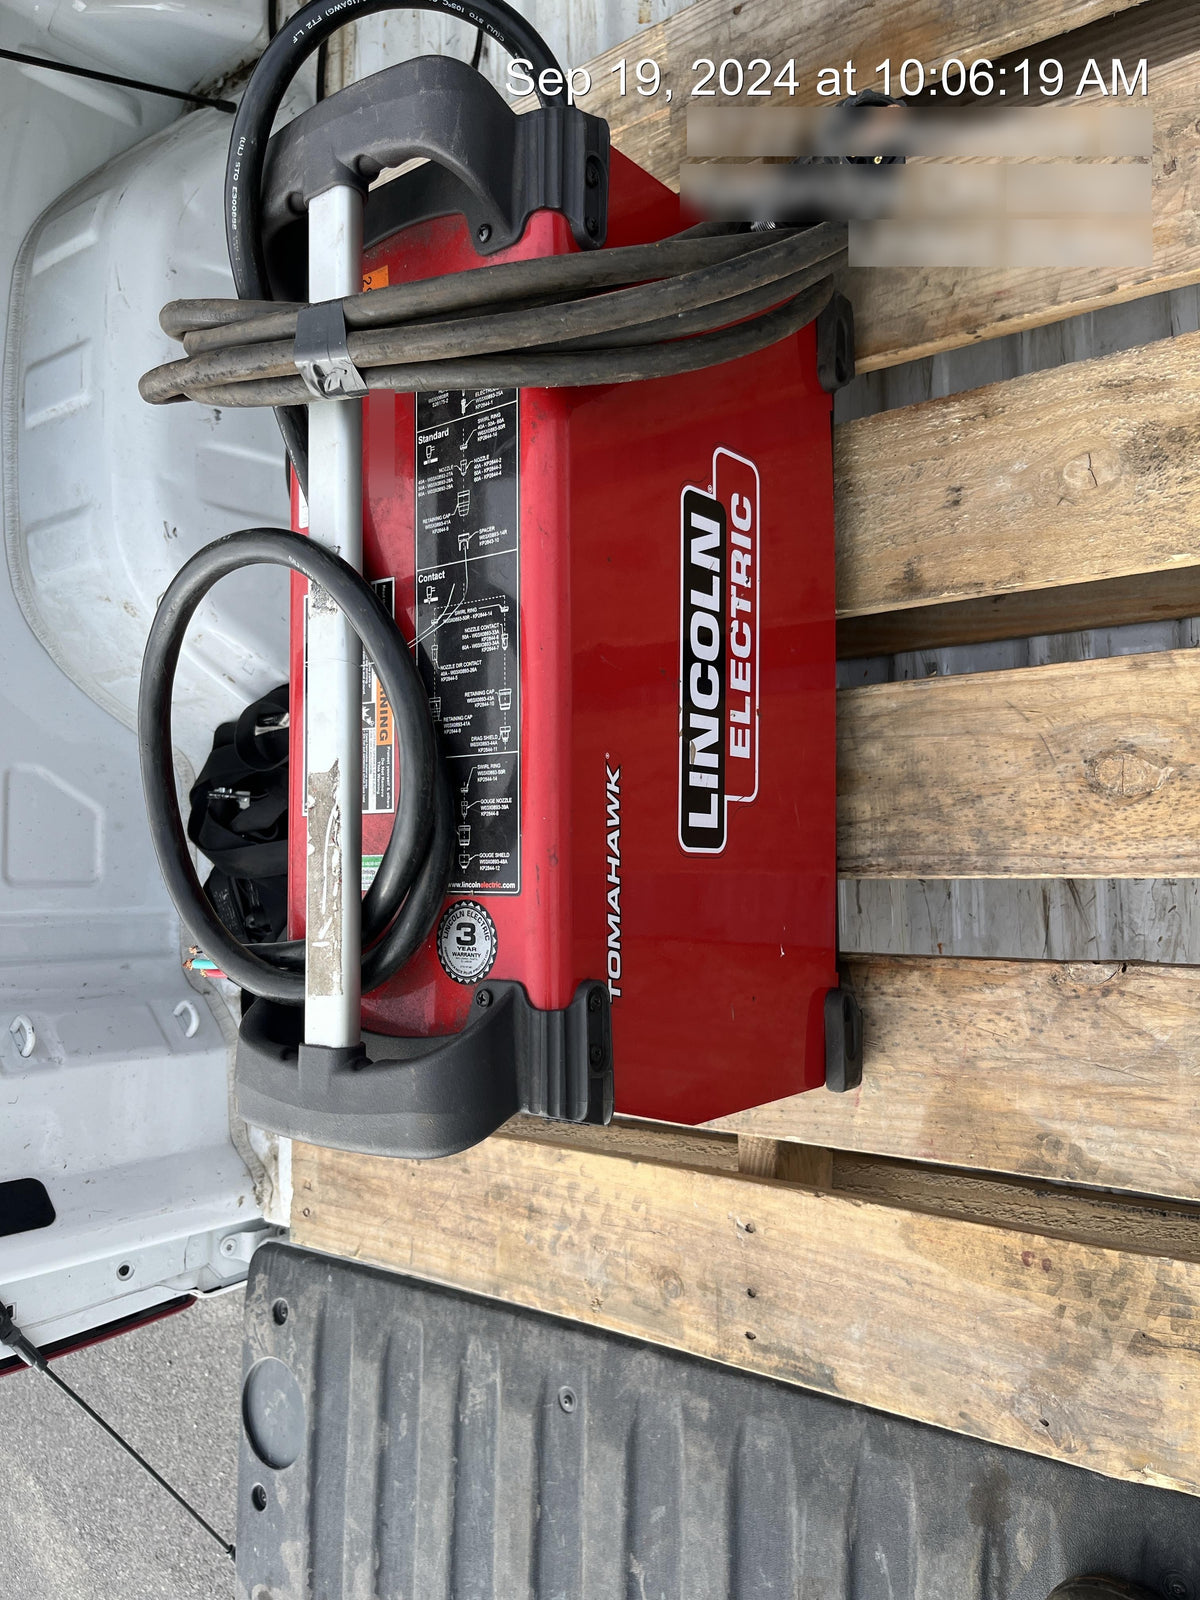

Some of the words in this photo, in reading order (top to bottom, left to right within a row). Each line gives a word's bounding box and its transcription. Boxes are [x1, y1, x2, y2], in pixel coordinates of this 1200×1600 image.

[305, 15, 323, 30] FT2
[469, 12, 485, 24] STO
[237, 136, 247, 156] (UL)
[233, 161, 241, 181] STO
[418, 427, 450, 445] Standard
[473, 454, 490, 463] NOZZLE
[479, 525, 496, 534] SPACER
[418, 570, 446, 584] Contact
[464, 625, 480, 633] NOZZLE
[480, 622, 500, 631] CONTACT
[729, 492, 753, 760] ELECTRIC
[463, 659, 482, 668] CONTACT
[688, 511, 721, 830] LINCOLN
[464, 689, 485, 697] RETAINING
[380, 687, 388, 741] NING
[447, 881, 516, 889] www.lincolnelectric.com
[606, 763, 622, 1004] TOMAHAWK
[443, 910, 465, 940] LINCOLN
[466, 910, 490, 942] ELECTRIC
[456, 922, 476, 946] 3
